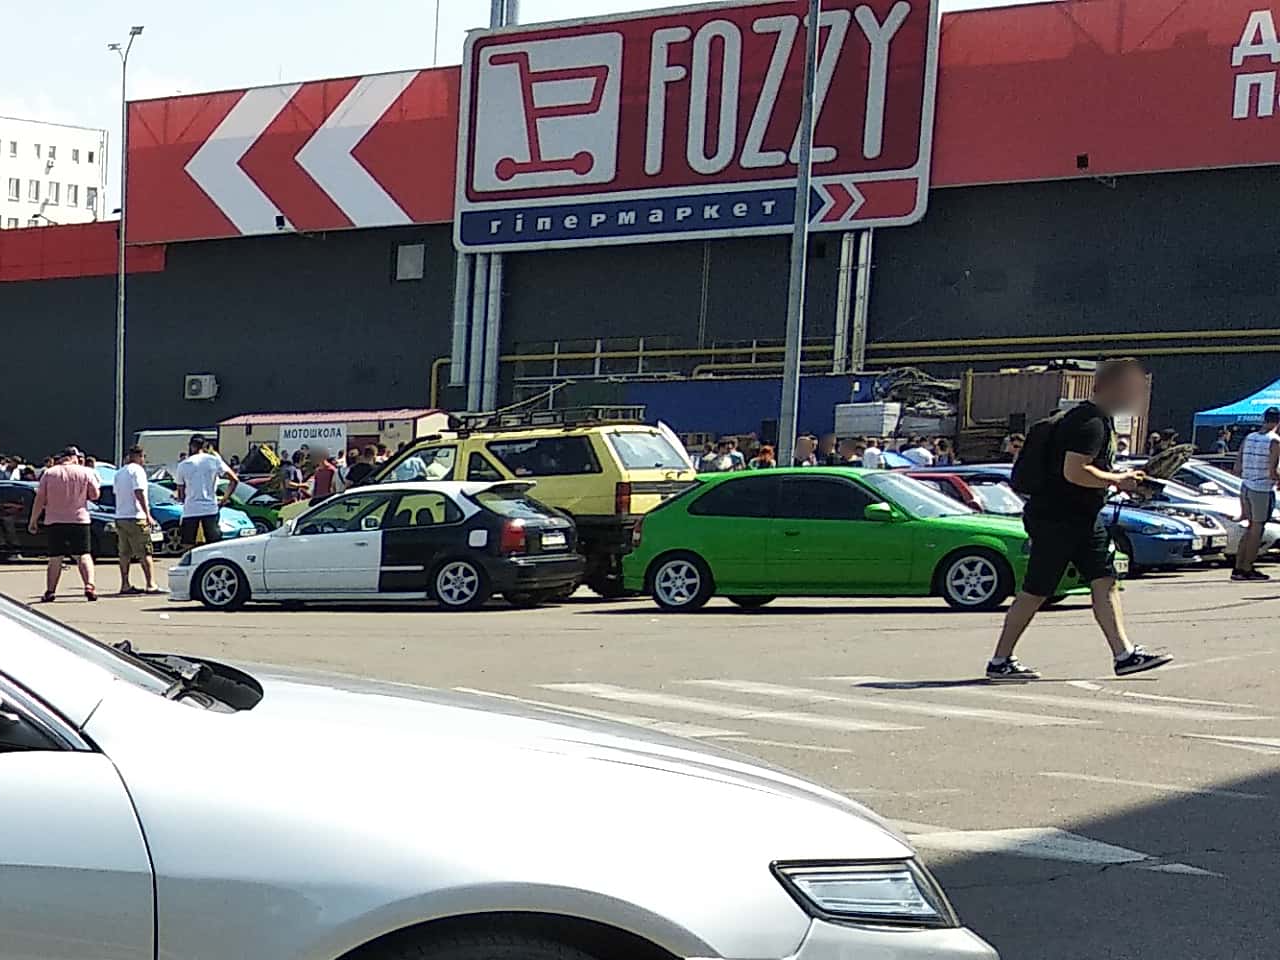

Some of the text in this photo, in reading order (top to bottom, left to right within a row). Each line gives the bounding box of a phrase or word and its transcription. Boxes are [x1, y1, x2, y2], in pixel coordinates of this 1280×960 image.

[643, 0, 911, 176] FOZZY
[1232, 71, 1280, 119] П
[490, 200, 776, 234] гіпермаркет
[283, 427, 342, 439] МОТОШКОЛА
